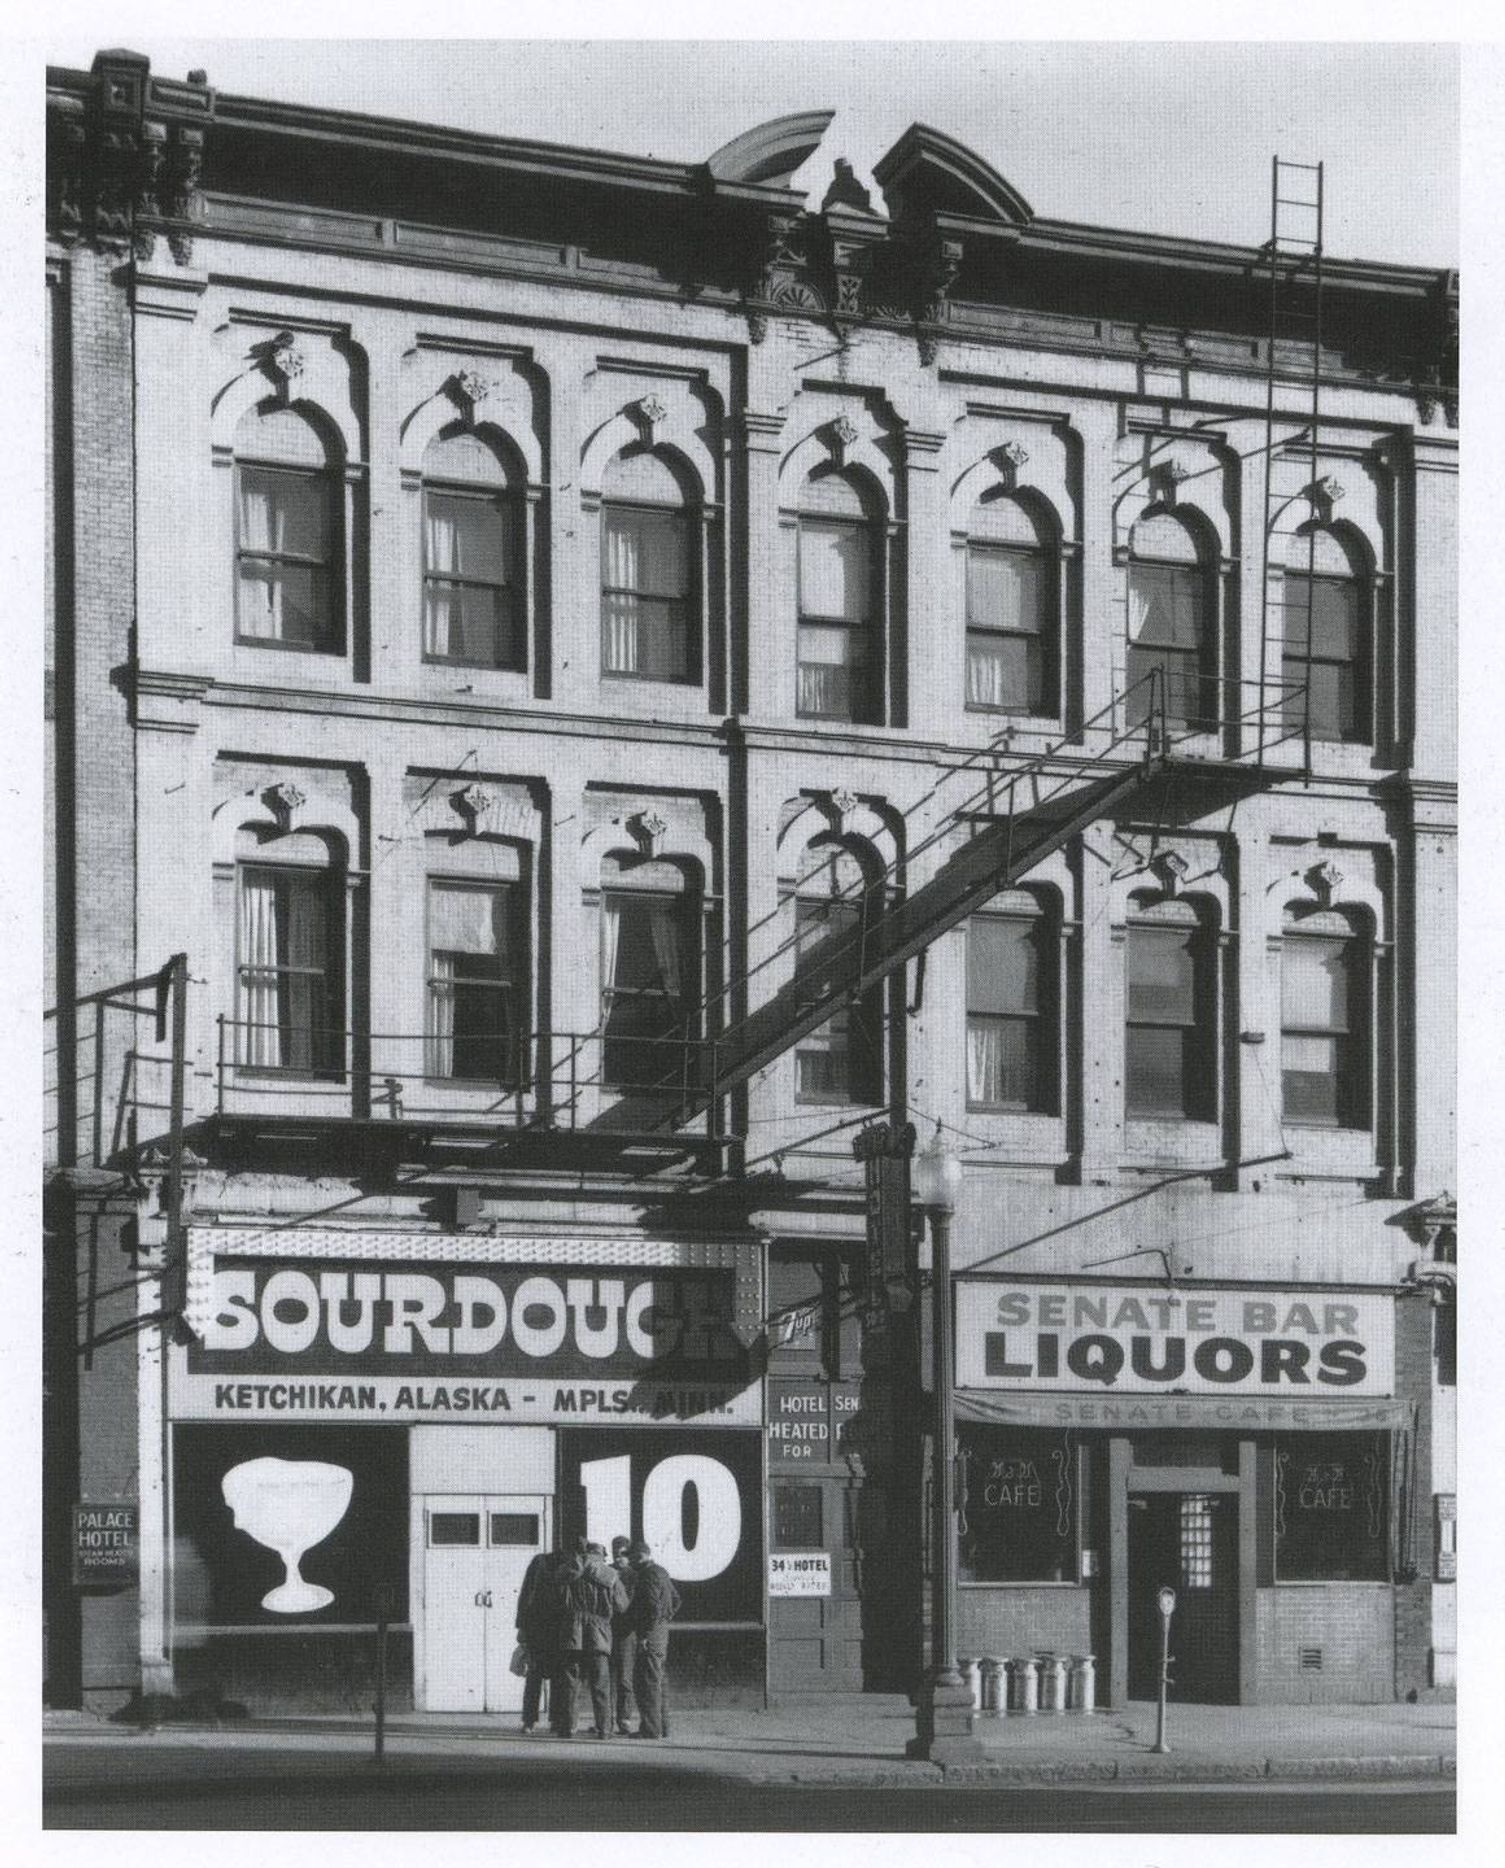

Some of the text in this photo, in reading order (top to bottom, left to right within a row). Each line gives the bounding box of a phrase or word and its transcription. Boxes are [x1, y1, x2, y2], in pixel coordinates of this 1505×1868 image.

[997, 1291, 1359, 1335] SENATE BAR
[985, 1331, 1367, 1386] LIQUORS
[215, 1384, 388, 1413] KETCHIKAN,
[394, 1386, 511, 1412] ALASKA
[780, 1396, 827, 1413] HOTEL
[1054, 1402, 1309, 1424] SENATE CAFE
[768, 1422, 829, 1440] HEATED
[783, 1444, 812, 1458] FOR
[984, 1484, 1041, 1507] CAFE
[1298, 1487, 1352, 1510] CAFE
[78, 1512, 134, 1529] PALACE
[580, 1454, 742, 1582] 10
[78, 1530, 134, 1548] HOTEL
[794, 1558, 829, 1573] HOTEL
